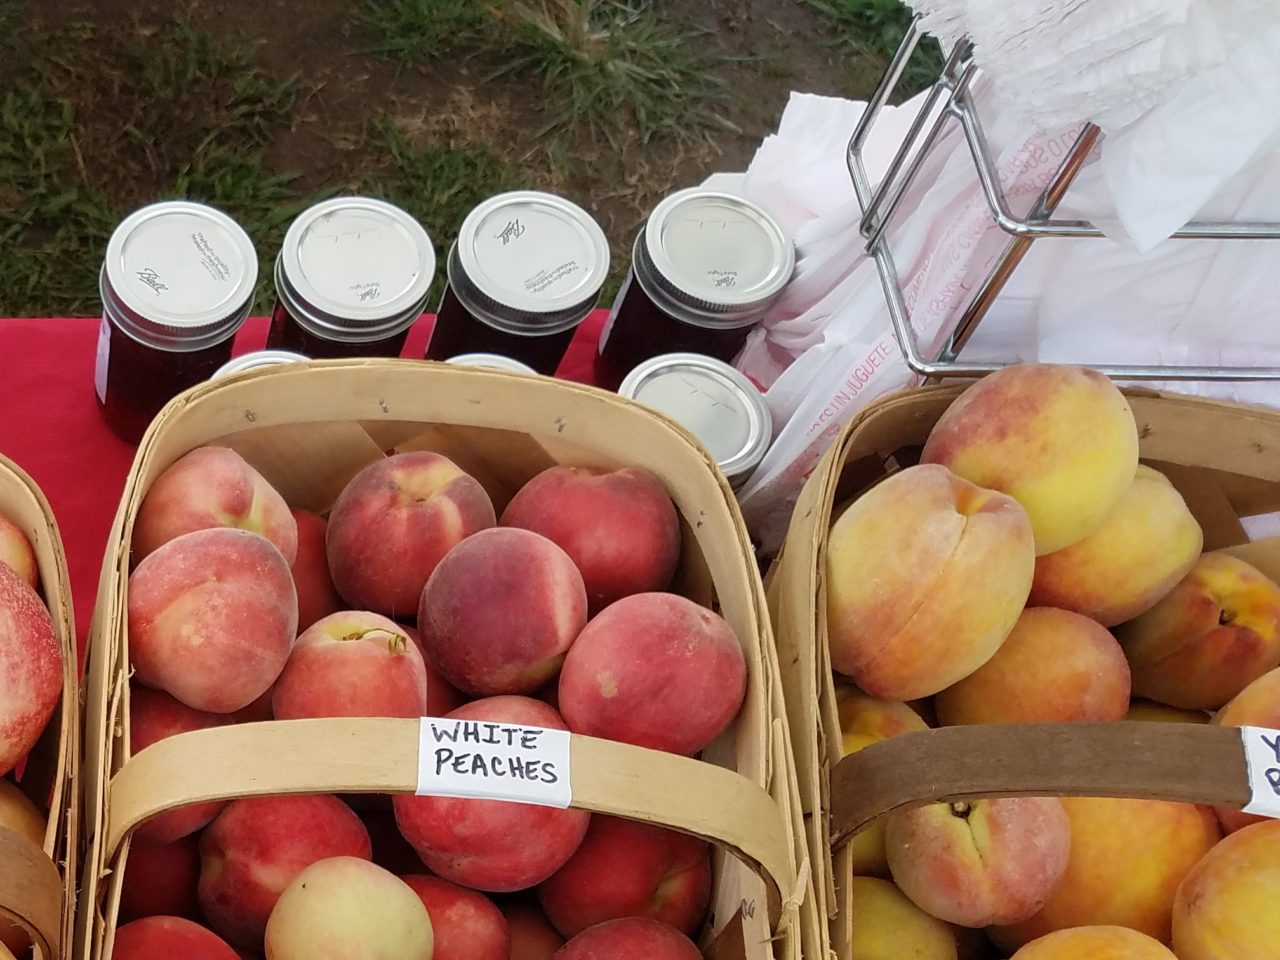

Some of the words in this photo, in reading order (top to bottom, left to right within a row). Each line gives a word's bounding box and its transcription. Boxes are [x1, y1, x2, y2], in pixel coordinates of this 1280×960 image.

[494, 218, 526, 246] Ball
[136, 267, 169, 294] Ball
[430, 721, 544, 749] WHITE
[434, 748, 558, 783] PEACHES
